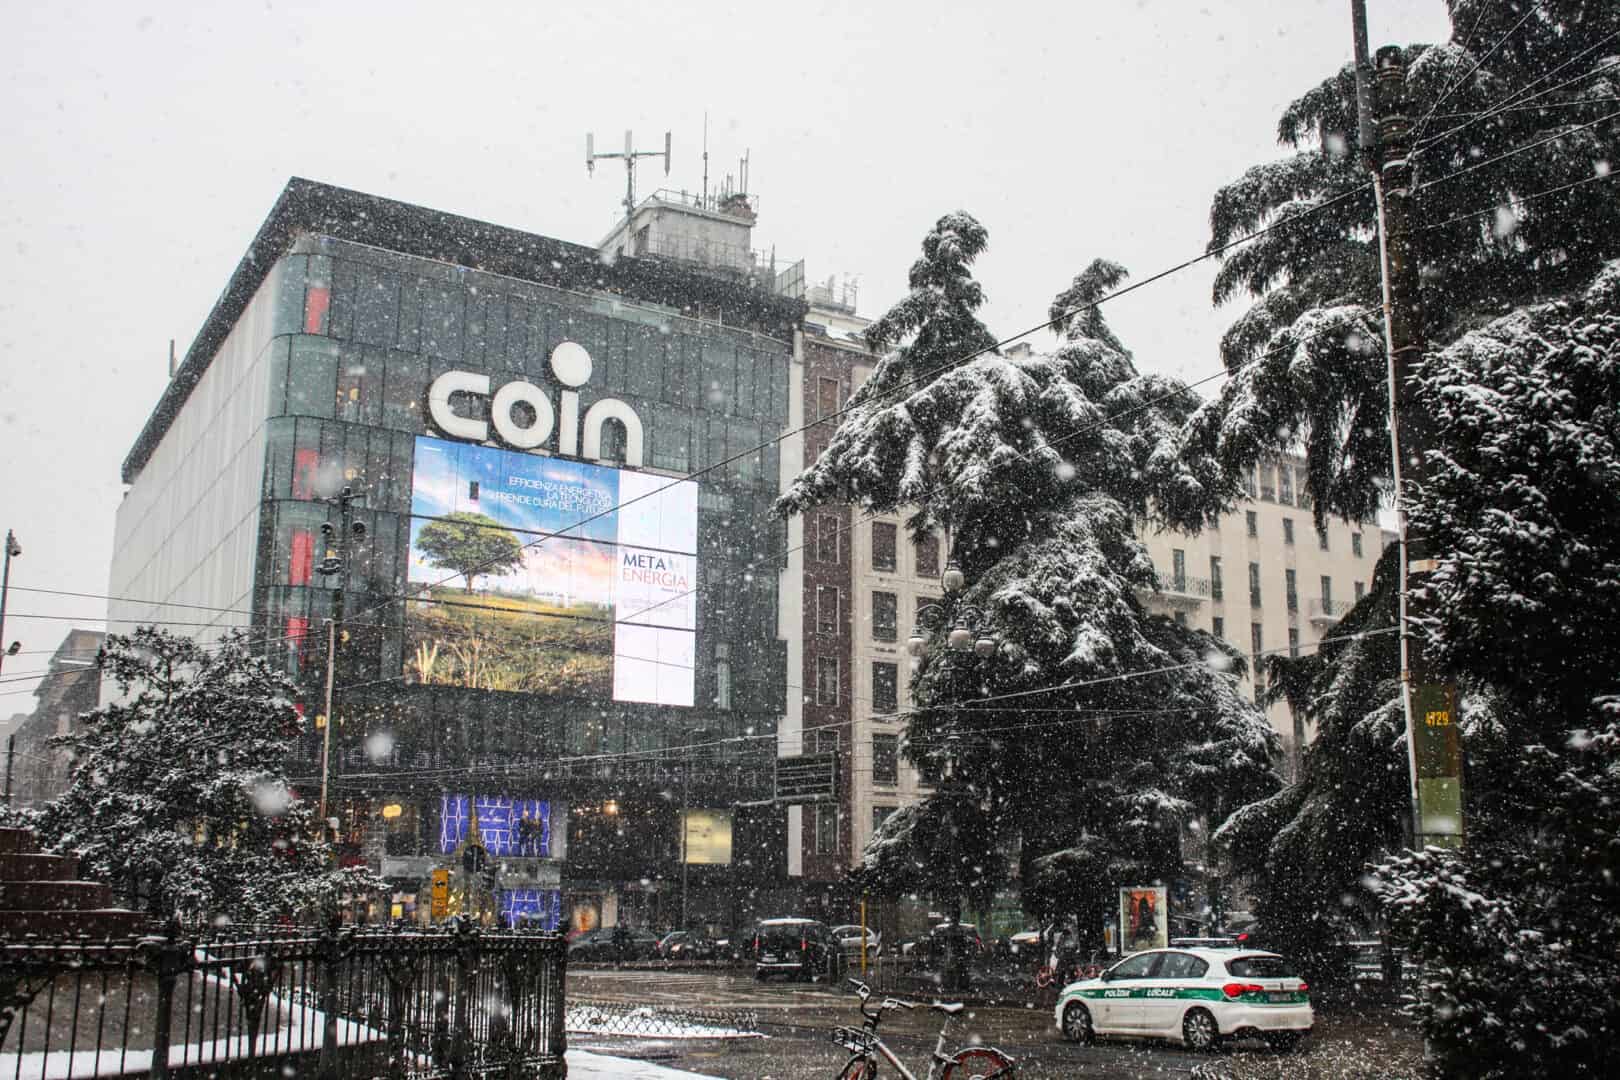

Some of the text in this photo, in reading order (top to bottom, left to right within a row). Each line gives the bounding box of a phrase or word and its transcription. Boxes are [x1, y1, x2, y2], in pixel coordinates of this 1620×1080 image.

[429, 342, 643, 466] coin
[624, 553, 666, 570] META
[623, 568, 688, 589] ENERGIA
[1146, 987, 1175, 997] LOCALE
